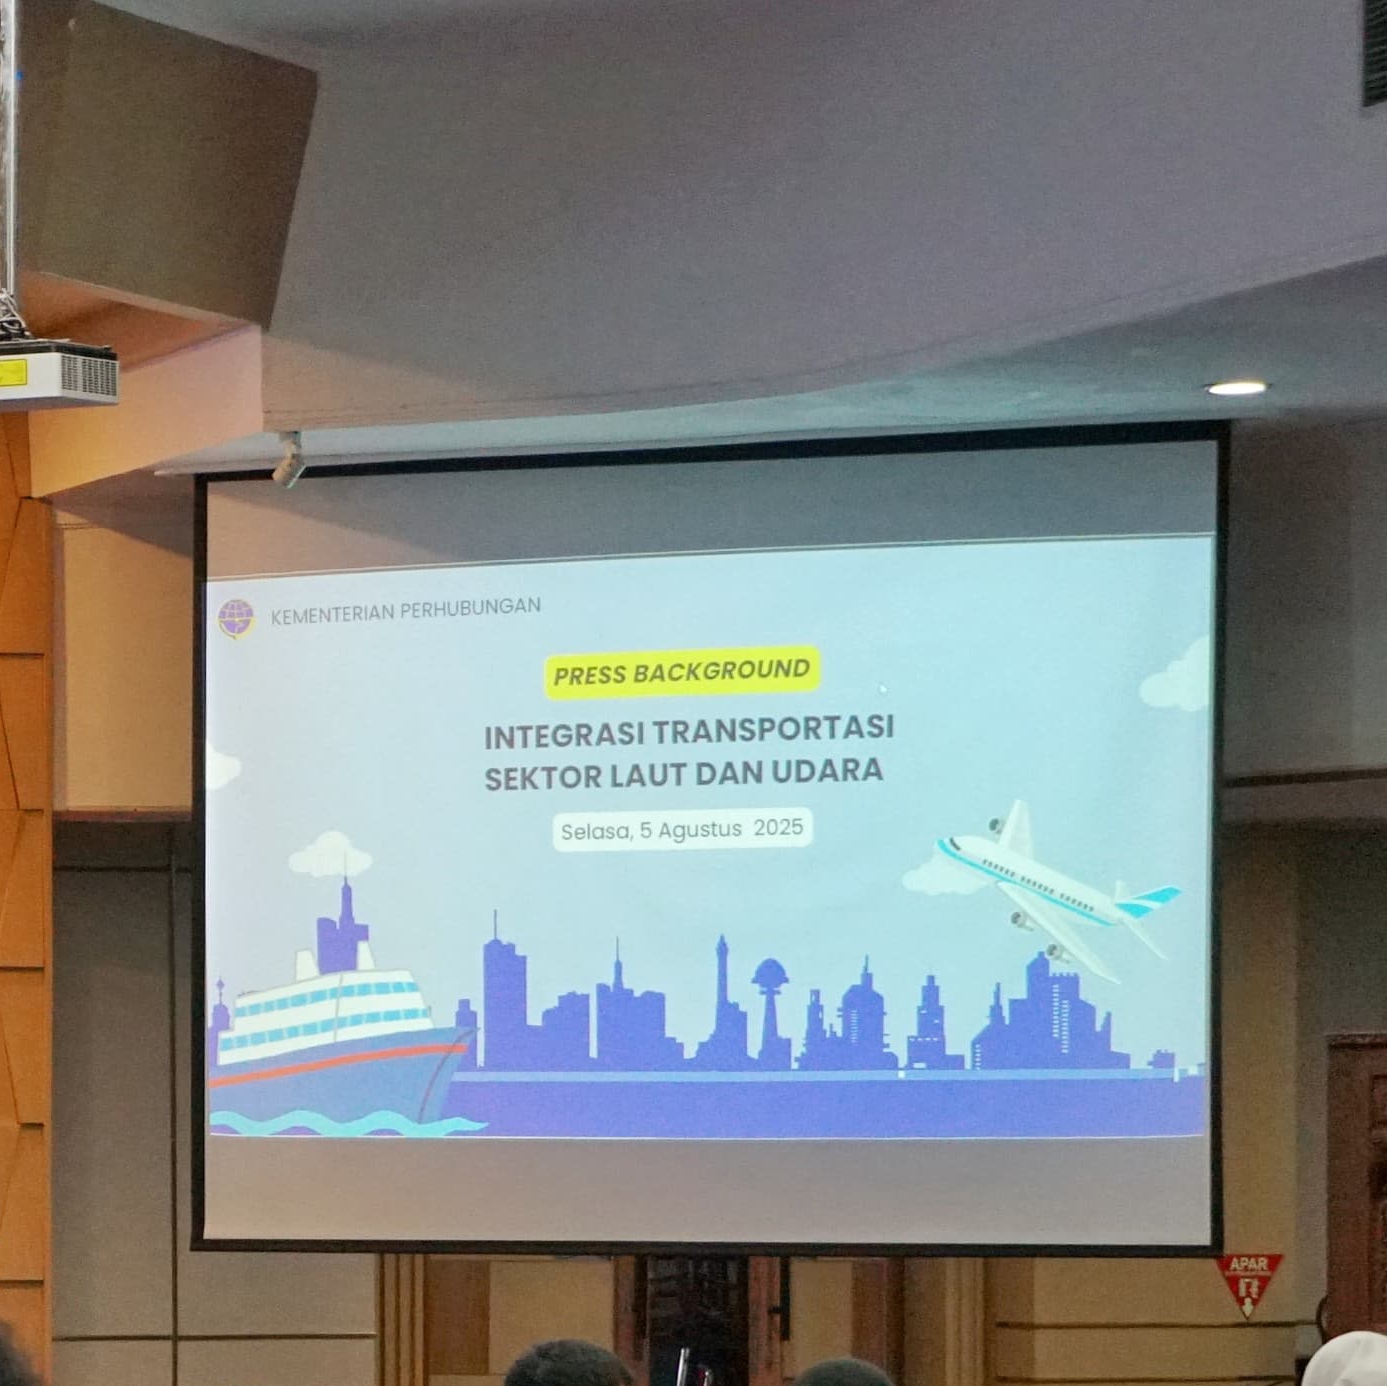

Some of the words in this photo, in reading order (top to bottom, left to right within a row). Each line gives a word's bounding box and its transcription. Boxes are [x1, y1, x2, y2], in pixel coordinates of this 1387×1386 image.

[271, 604, 395, 626] KEMENTERIAN
[400, 596, 541, 619] PERHUBUNGAN
[554, 664, 627, 686] PRESS
[633, 658, 811, 683] BACKGROUND
[485, 721, 644, 750] INTEGRASI
[652, 714, 894, 745] TRANSPORTASI
[485, 764, 602, 792] SEKTOR
[610, 762, 688, 788] LAUT
[696, 760, 763, 786] DAN
[772, 757, 884, 784] UDARA
[561, 823, 634, 844] Selasa,
[640, 821, 653, 839] 5
[658, 821, 742, 844] Agustus
[754, 817, 804, 836] 2025
[1230, 1257, 1268, 1271] APAR
